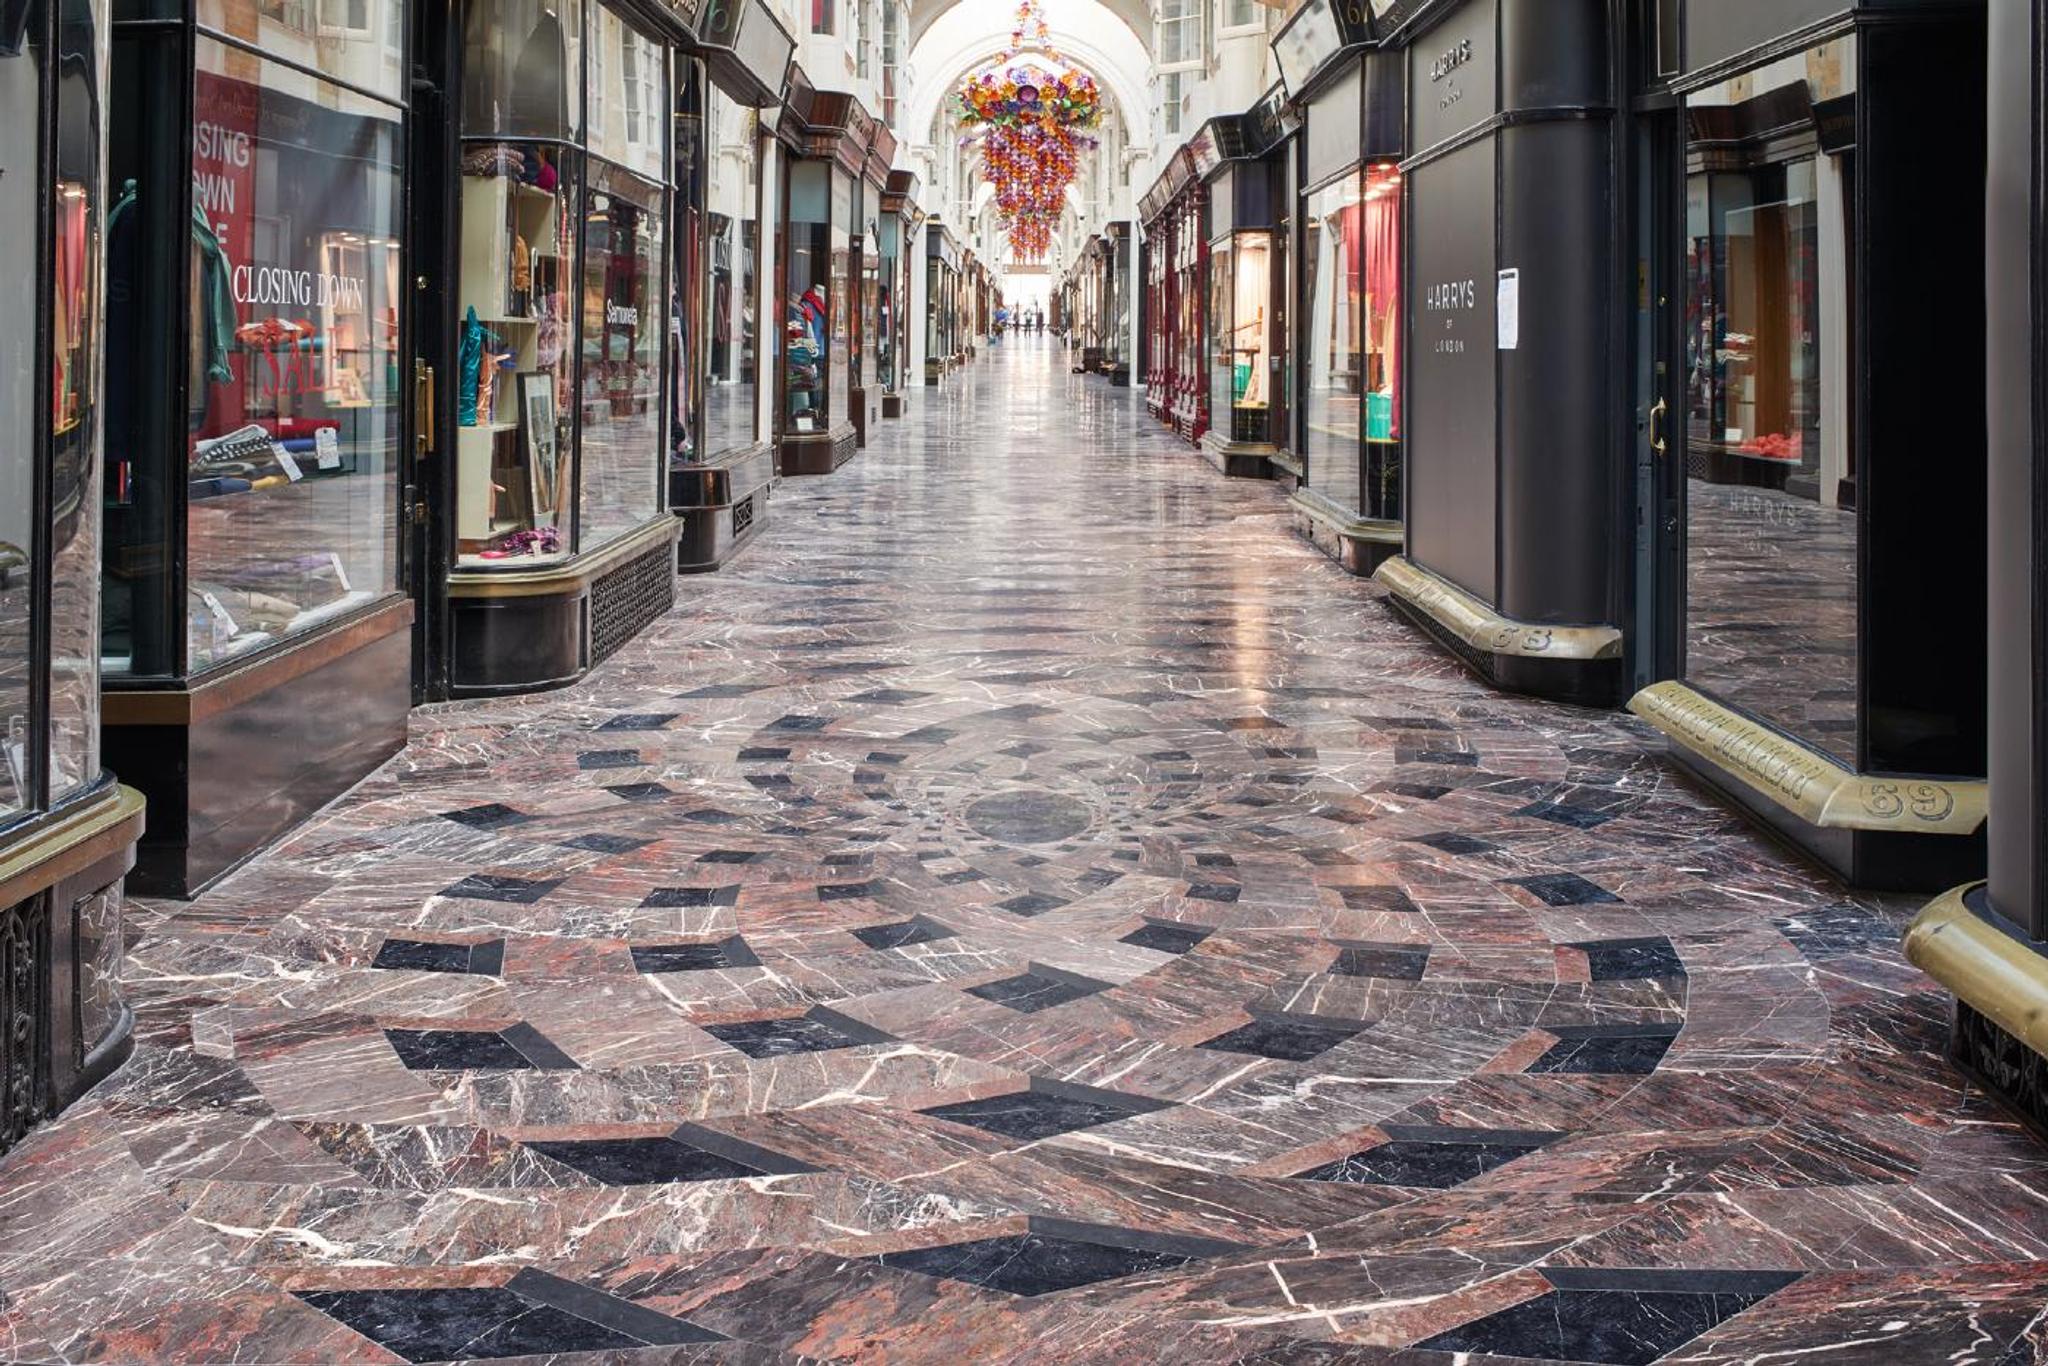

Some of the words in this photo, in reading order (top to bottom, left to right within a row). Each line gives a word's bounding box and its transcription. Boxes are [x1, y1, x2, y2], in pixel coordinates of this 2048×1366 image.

[1430, 39, 1471, 82] HARRYS
[233, 264, 311, 306] CLOSING
[316, 273, 364, 311] DOWN
[1427, 279, 1475, 310] HARRYS
[263, 327, 345, 397] SALE
[1434, 339, 1465, 353] LONDON
